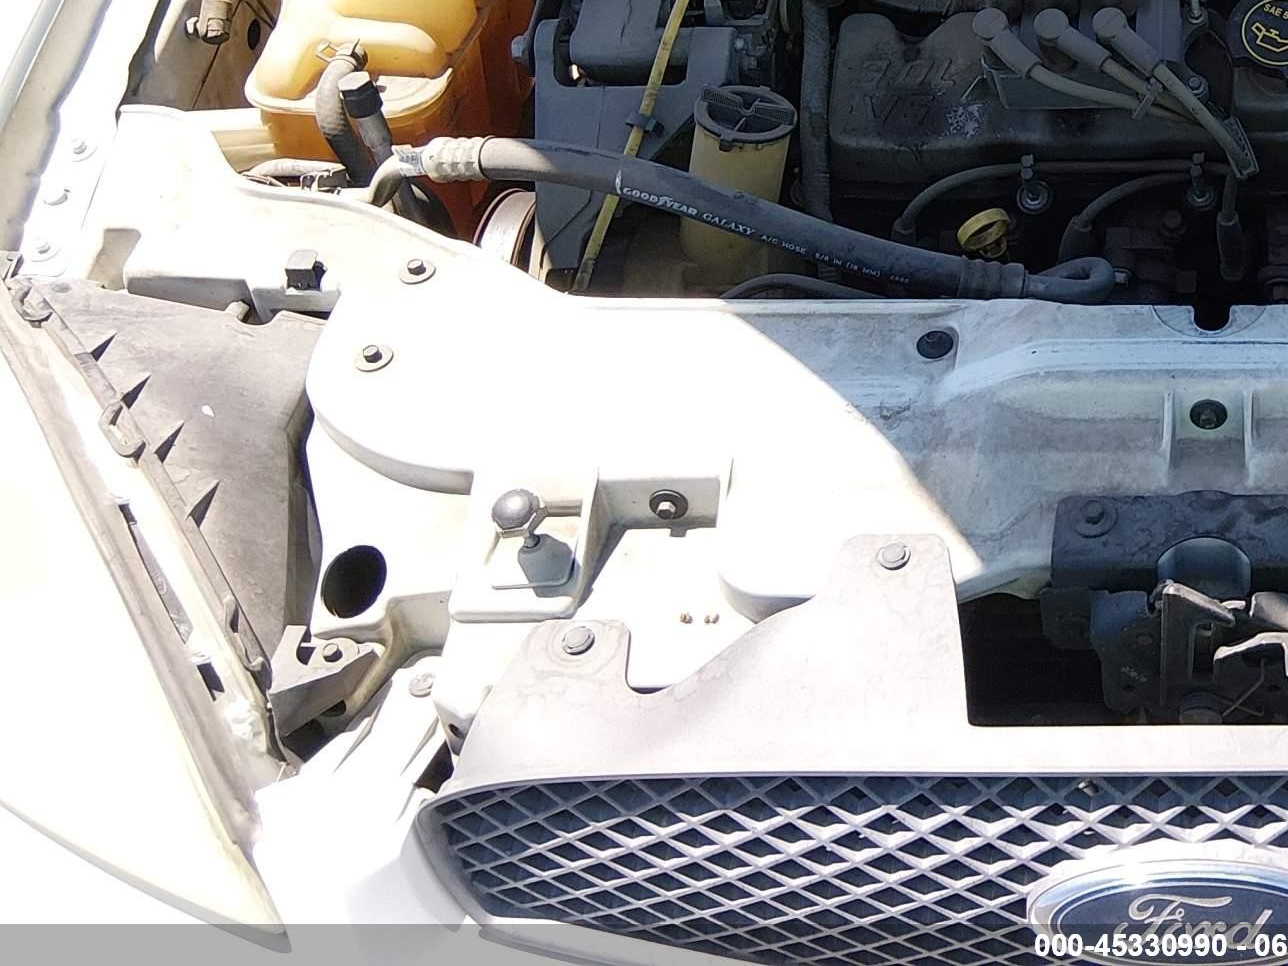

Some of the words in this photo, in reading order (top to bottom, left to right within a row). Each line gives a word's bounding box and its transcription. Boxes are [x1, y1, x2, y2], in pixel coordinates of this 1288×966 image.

[1263, 3, 1282, 17] SAE
[622, 187, 698, 216] GOODYEAR
[703, 212, 756, 235] GALAXY
[761, 234, 778, 245] A/C
[782, 241, 806, 255] HOSE
[833, 258, 842, 266] IN
[862, 267, 881, 278] MM)
[1114, 893, 1273, 949] Ford
